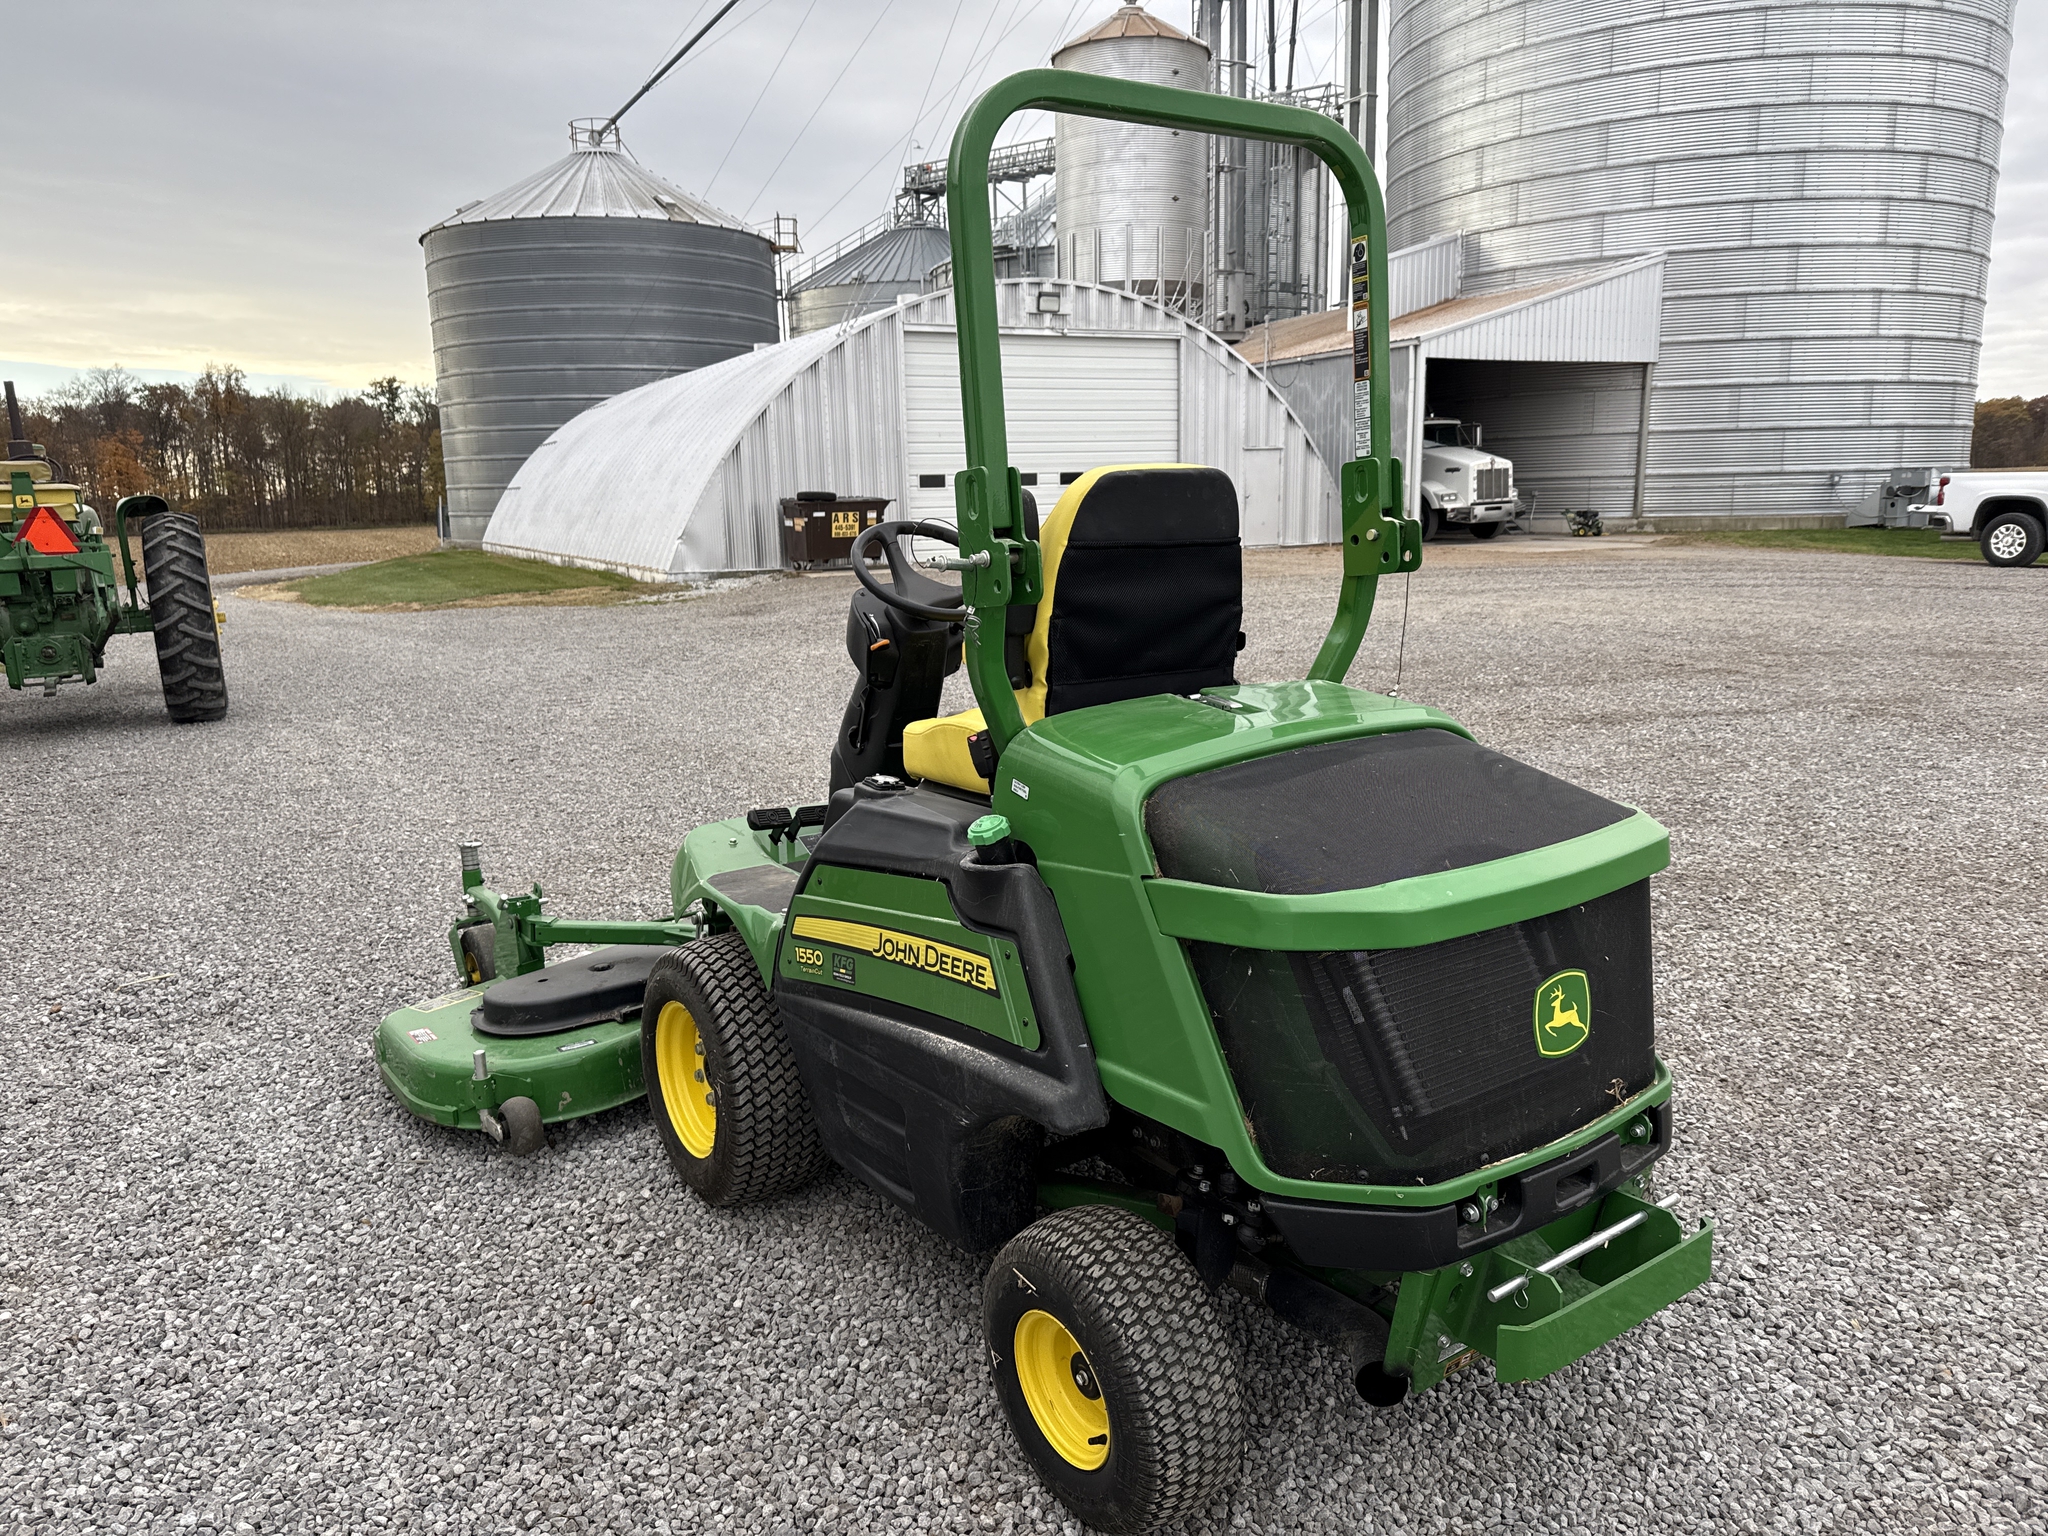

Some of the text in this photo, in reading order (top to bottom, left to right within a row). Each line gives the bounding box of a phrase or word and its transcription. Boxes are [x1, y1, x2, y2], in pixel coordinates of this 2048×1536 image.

[795, 946, 823, 966] 1550
[834, 954, 854, 971] KFG
[873, 932, 987, 986] JOHN DEERE
